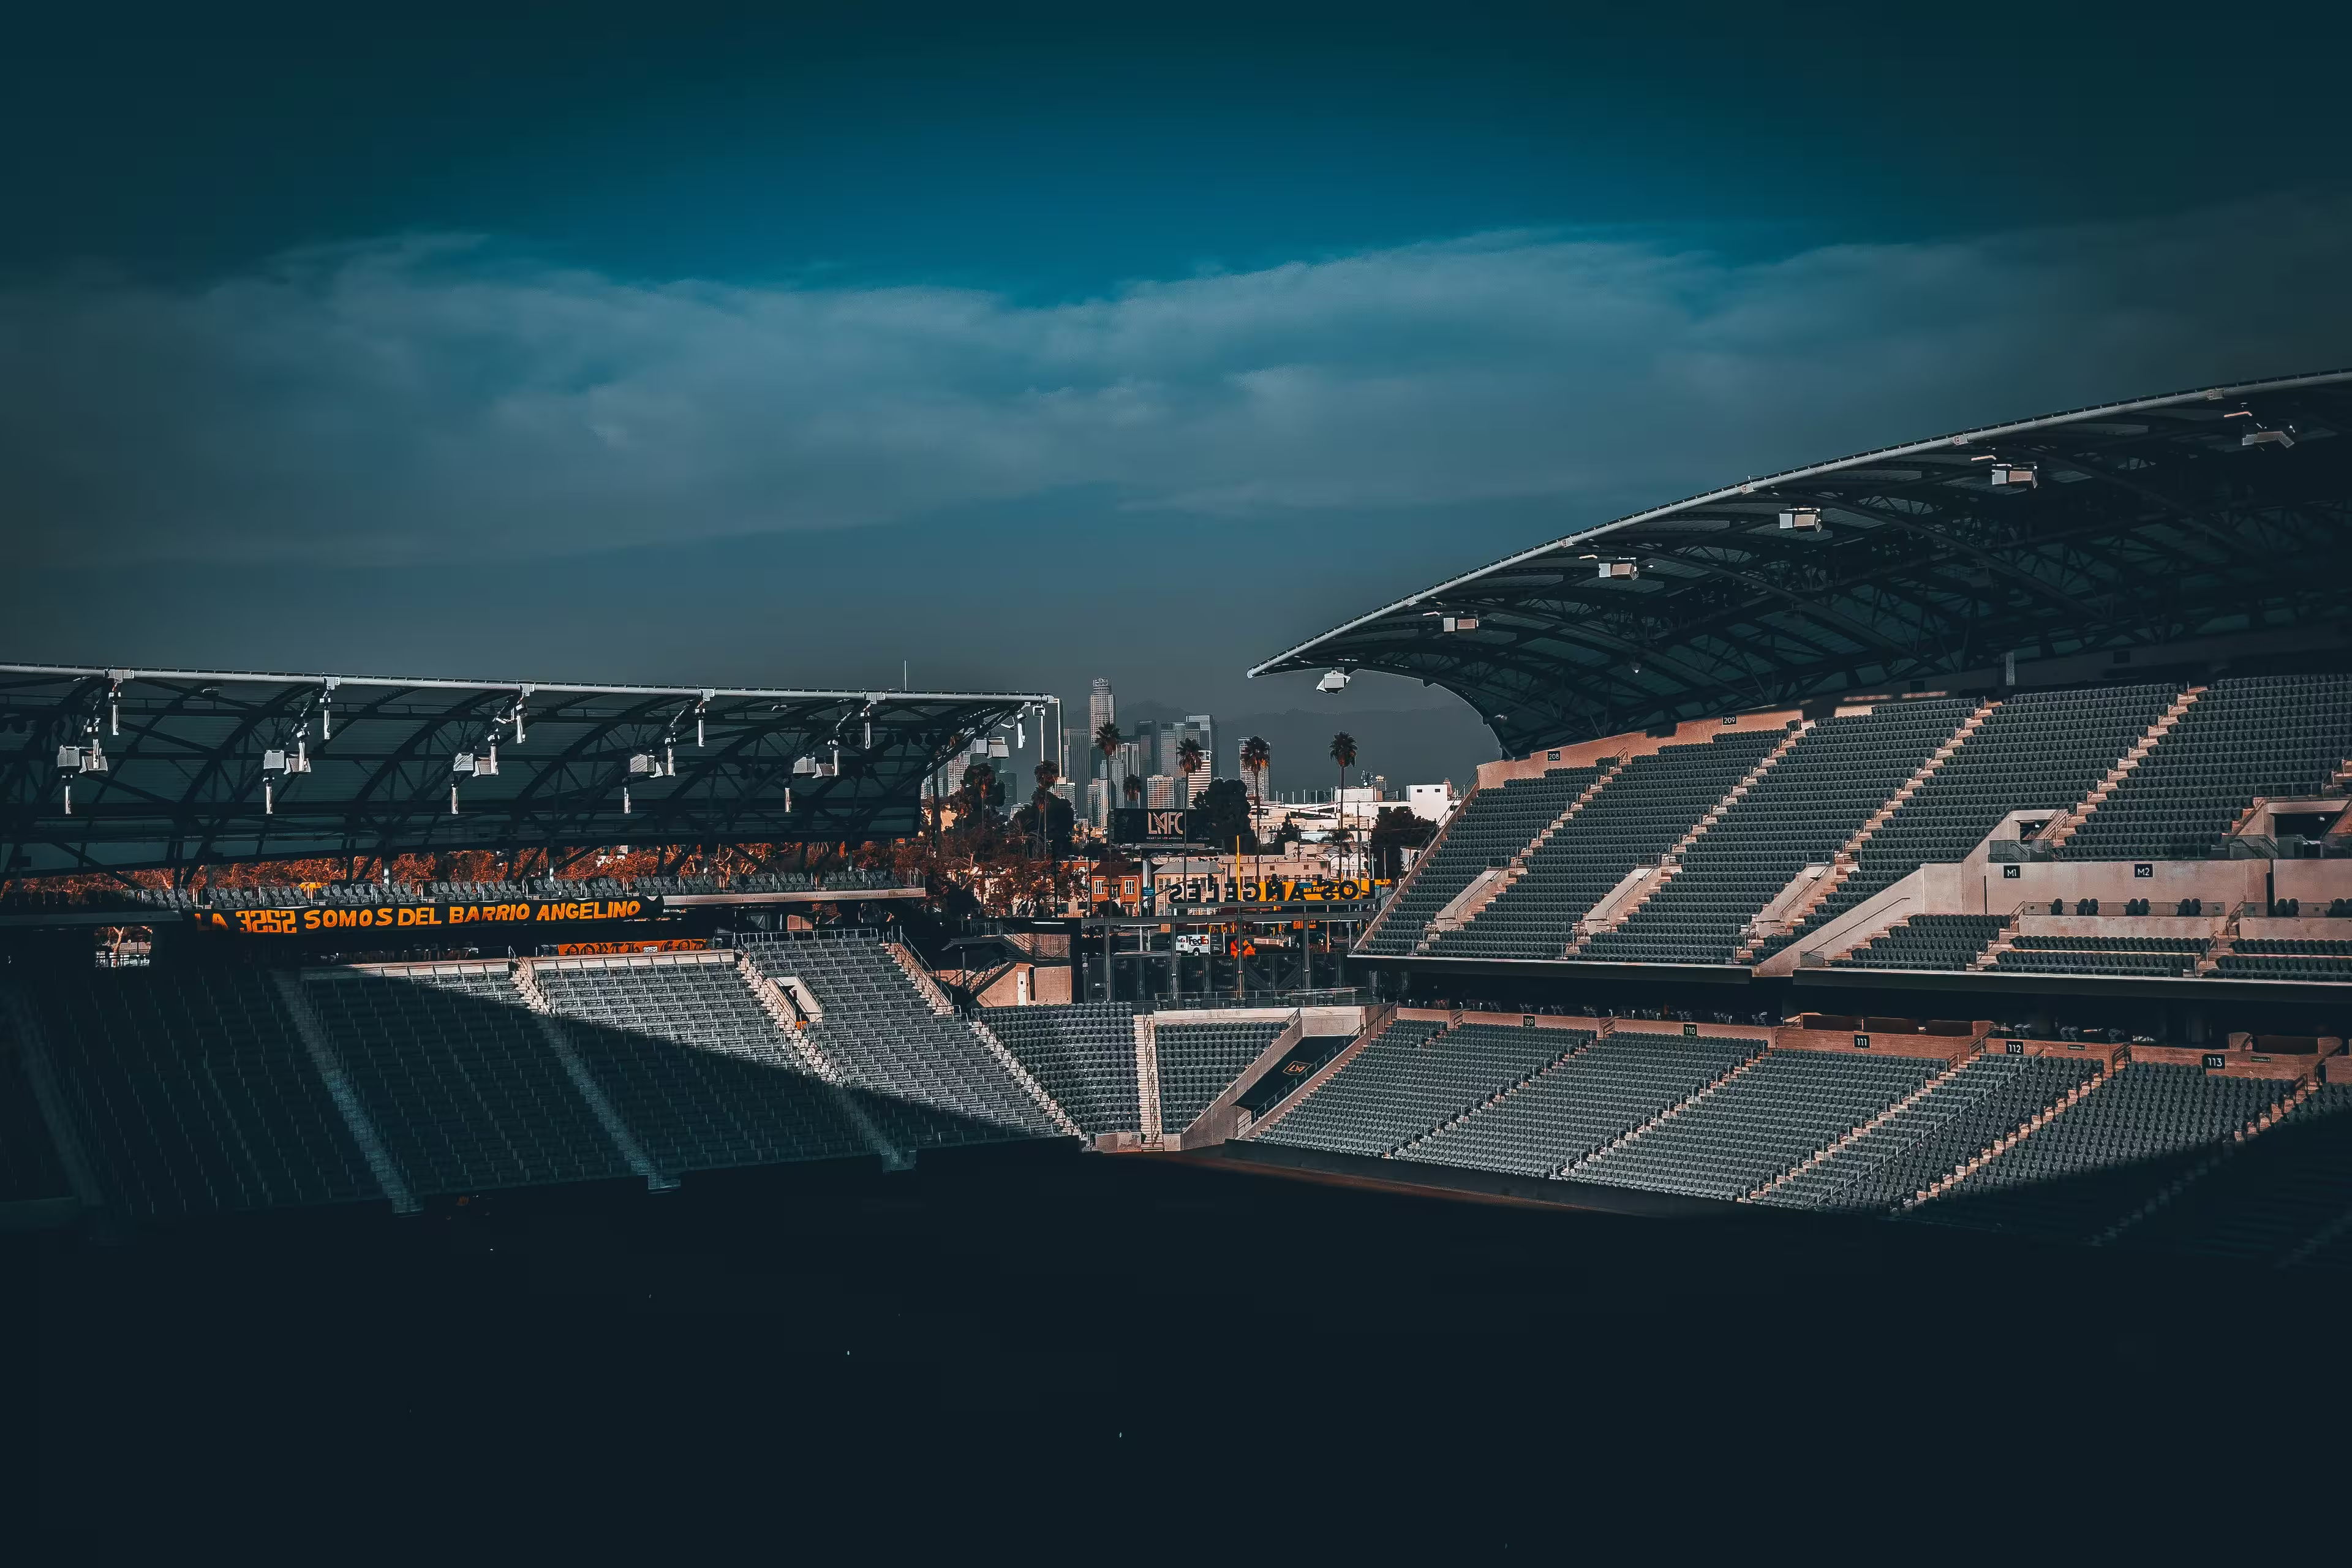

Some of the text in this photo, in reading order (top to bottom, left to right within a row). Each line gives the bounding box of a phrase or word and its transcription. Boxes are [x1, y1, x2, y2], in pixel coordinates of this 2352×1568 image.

[2138, 867, 2150, 876] M2
[194, 900, 641, 933] LA 3252 SOMOS DEL BARRIO ANGELINO
[1856, 1038, 1867, 1046] 111
[2008, 1044, 2021, 1054] 112
[2207, 1057, 2223, 1067] 113
